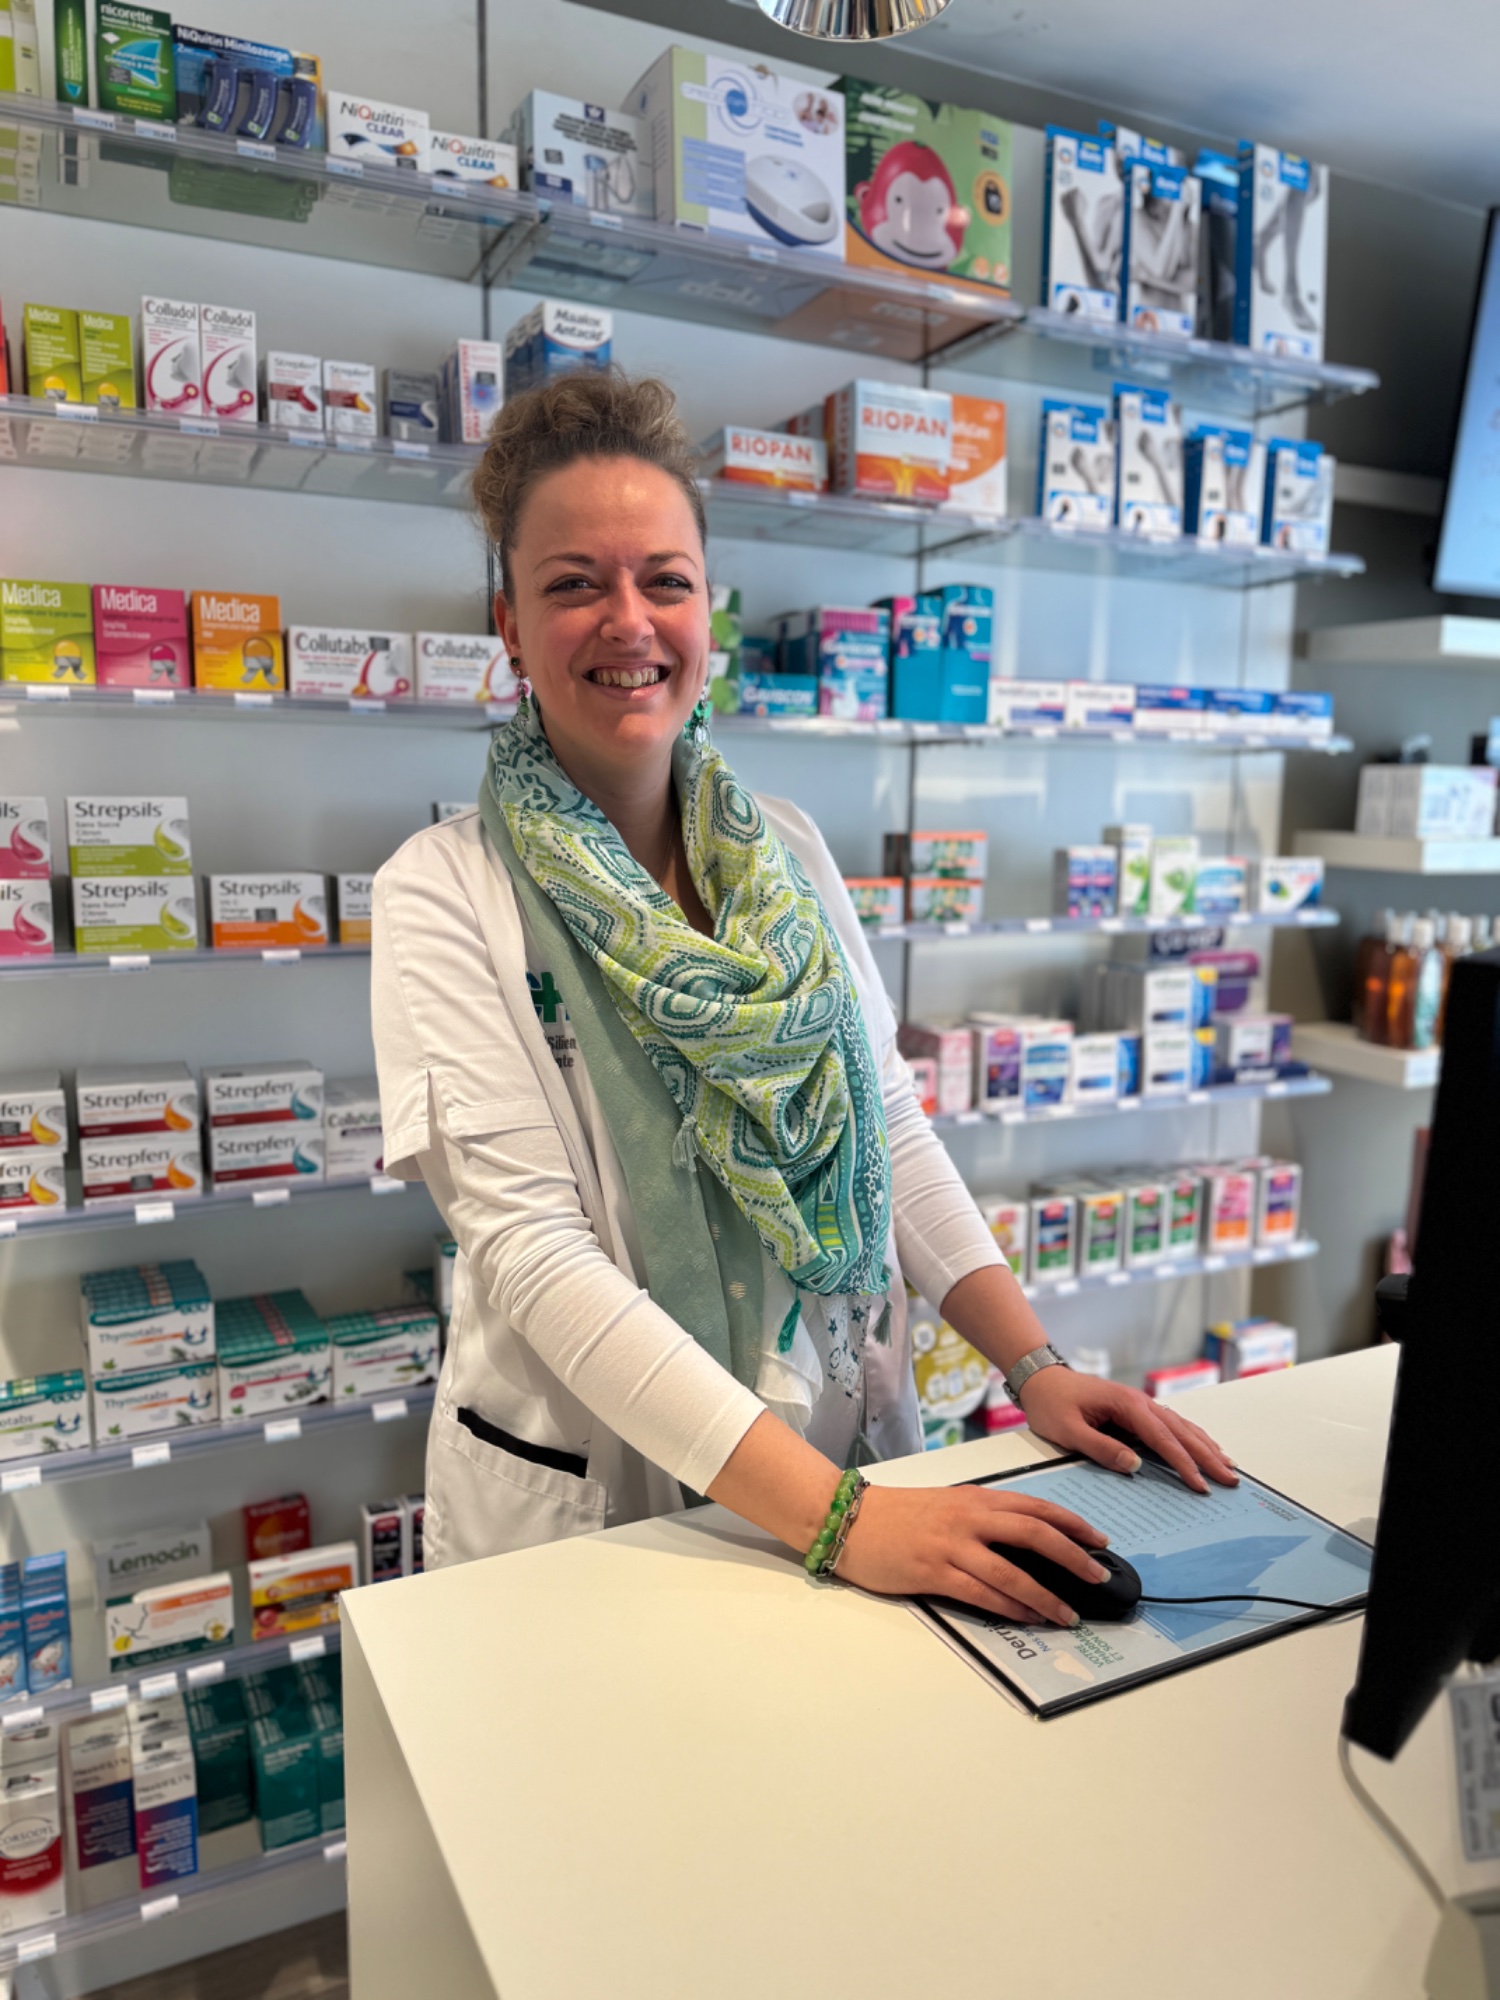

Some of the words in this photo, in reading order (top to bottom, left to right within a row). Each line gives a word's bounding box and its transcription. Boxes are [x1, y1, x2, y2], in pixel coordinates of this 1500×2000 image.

[101, 3, 154, 24] nicorette
[177, 27, 223, 47] NiQuitin
[225, 37, 290, 62] Minilozenge
[340, 101, 404, 127] NiQuitin
[366, 122, 404, 139] CLEAR
[431, 136, 495, 159] NiQuitin
[457, 155, 495, 172] CLEAR
[28, 307, 60, 324] Medica
[145, 299, 197, 320] Colludol
[202, 306, 253, 328] Colludol
[83, 314, 114, 331] Medica
[861, 407, 948, 440] RIOPAN
[731, 433, 813, 465] RIOPAN
[1, 582, 62, 608] Medica
[101, 587, 157, 613] Medica
[200, 596, 261, 624] Medica
[295, 632, 369, 655] Collutabs
[422, 638, 491, 660] Collutabs
[75, 801, 163, 821] Strepsils
[75, 821, 95, 829] Sans
[97, 821, 120, 829] Sucre
[81, 881, 169, 901] Strepsils
[219, 880, 301, 899] Strepsils
[81, 901, 101, 909] Sans
[103, 901, 126, 909] Sucre
[84, 1090, 168, 1110] Strepfen
[215, 1080, 294, 1100] Strepfen
[218, 1135, 295, 1155] Strepfen
[88, 1150, 170, 1170] Strepfen
[98, 1326, 164, 1343] Thymotabs
[104, 1391, 169, 1409] Thymotabs
[108, 1541, 199, 1575] Lemocin
[984, 1621, 1038, 1660] Derriè
[1032, 1637, 1051, 1652] Nos
[1070, 1629, 1115, 1665] PHARMAC
[1093, 1636, 1113, 1652] SON
[1074, 1644, 1104, 1668] VOTRE
[1111, 1651, 1124, 1661] ET
